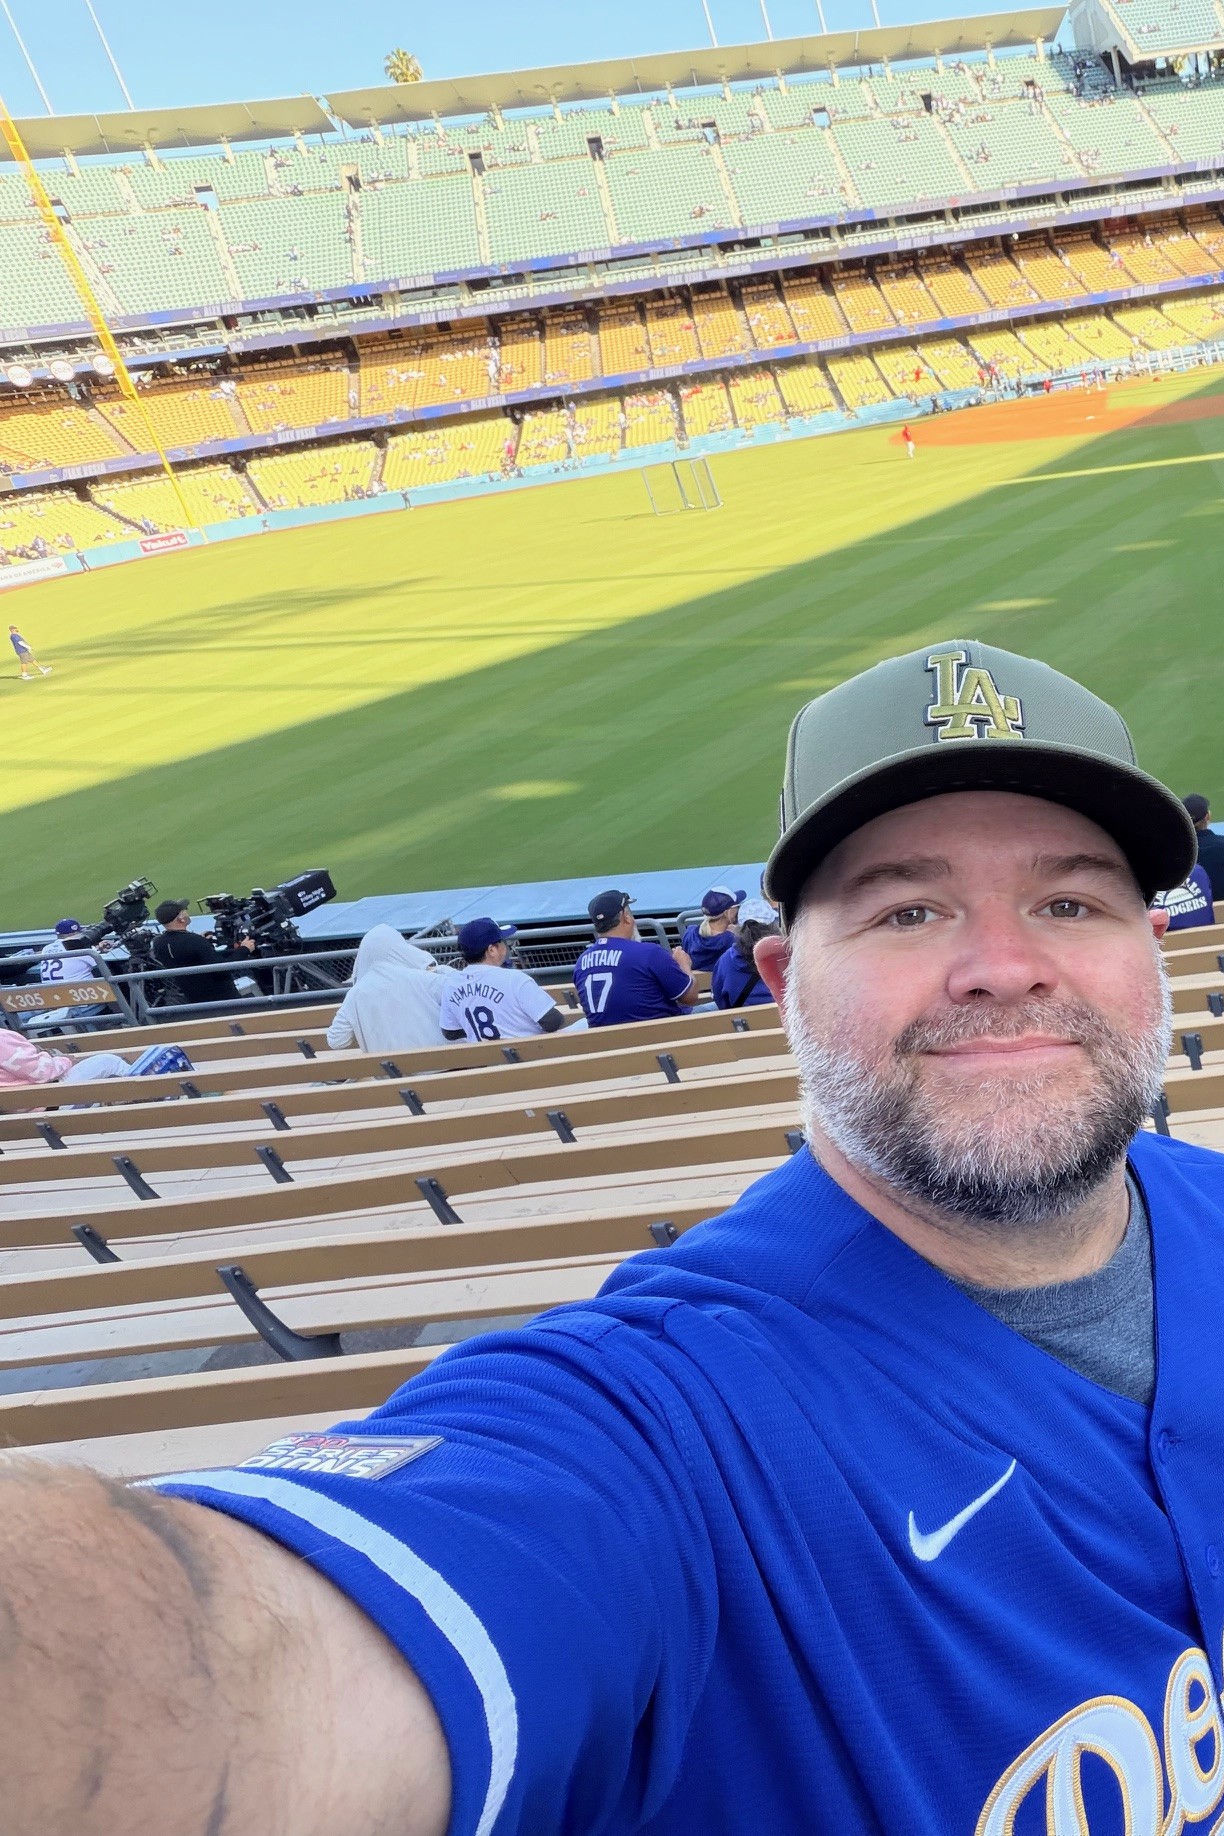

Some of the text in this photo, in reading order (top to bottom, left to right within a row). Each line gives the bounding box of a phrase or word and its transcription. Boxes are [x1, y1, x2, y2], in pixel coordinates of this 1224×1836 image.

[142, 535, 187, 551] Yakult
[926, 650, 1024, 741] LA
[1164, 896, 1208, 917] ODGERS
[41, 958, 64, 981] 22
[581, 949, 622, 971] OHTANI
[14, 986, 99, 1008] 305 303
[450, 983, 504, 1007] YAMAMOTO
[585, 972, 613, 1014] 17
[465, 1005, 501, 1042] 18
[262, 1445, 401, 1459] SERIES
